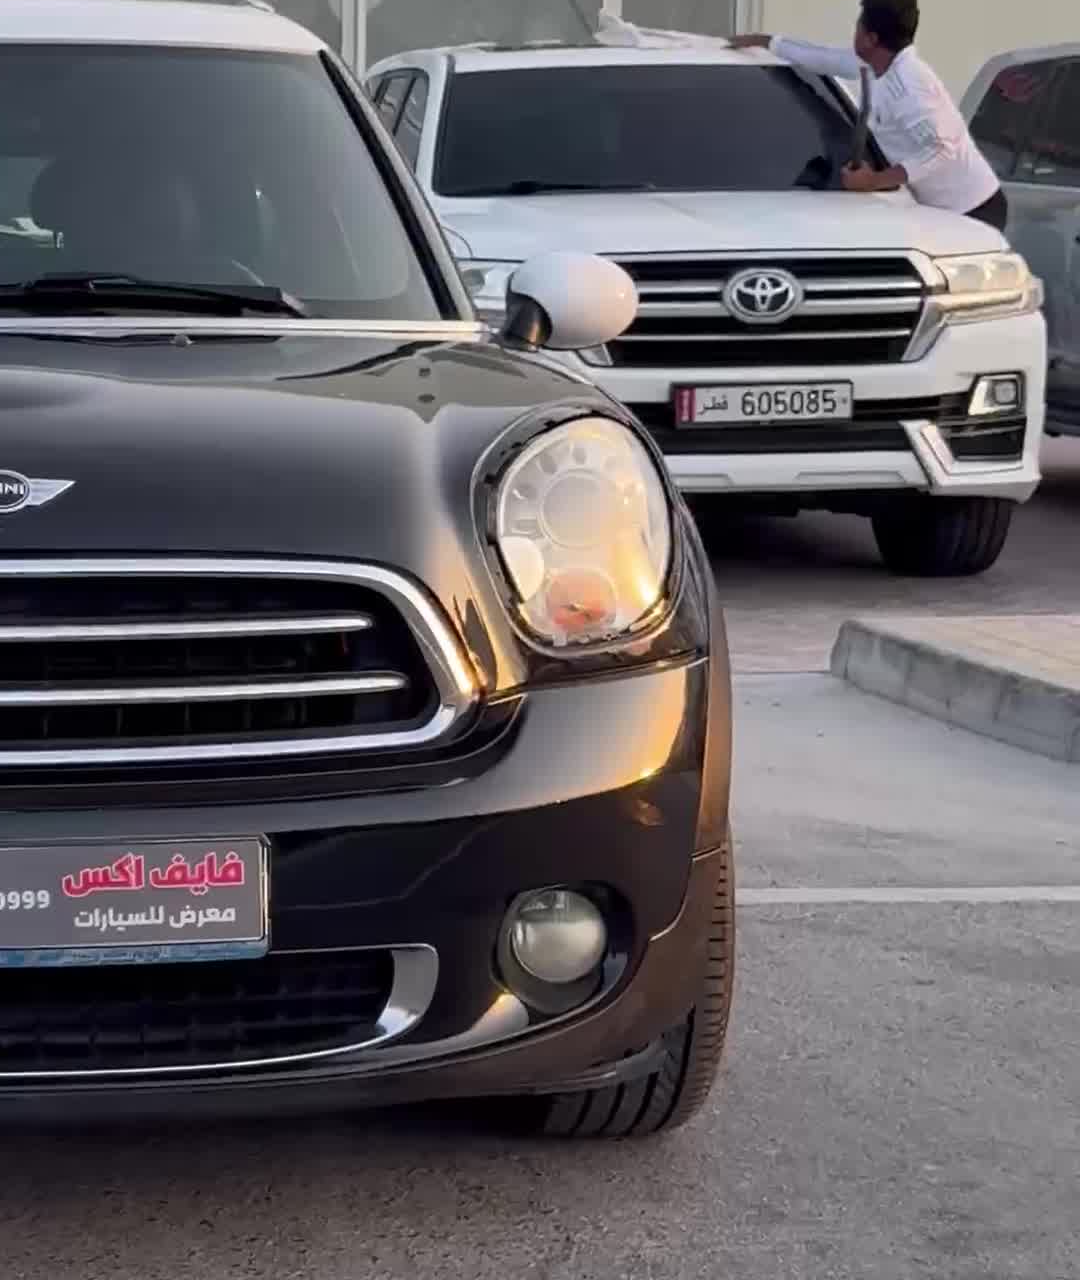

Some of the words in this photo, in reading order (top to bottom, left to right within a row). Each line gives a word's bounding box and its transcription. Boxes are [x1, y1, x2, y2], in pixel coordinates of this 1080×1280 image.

[741, 389, 837, 416] 605085
[62, 852, 145, 898] اكس
[149, 851, 245, 895] فايف
[74, 905, 165, 932] للسيارات
[169, 905, 236, 928] معرض
